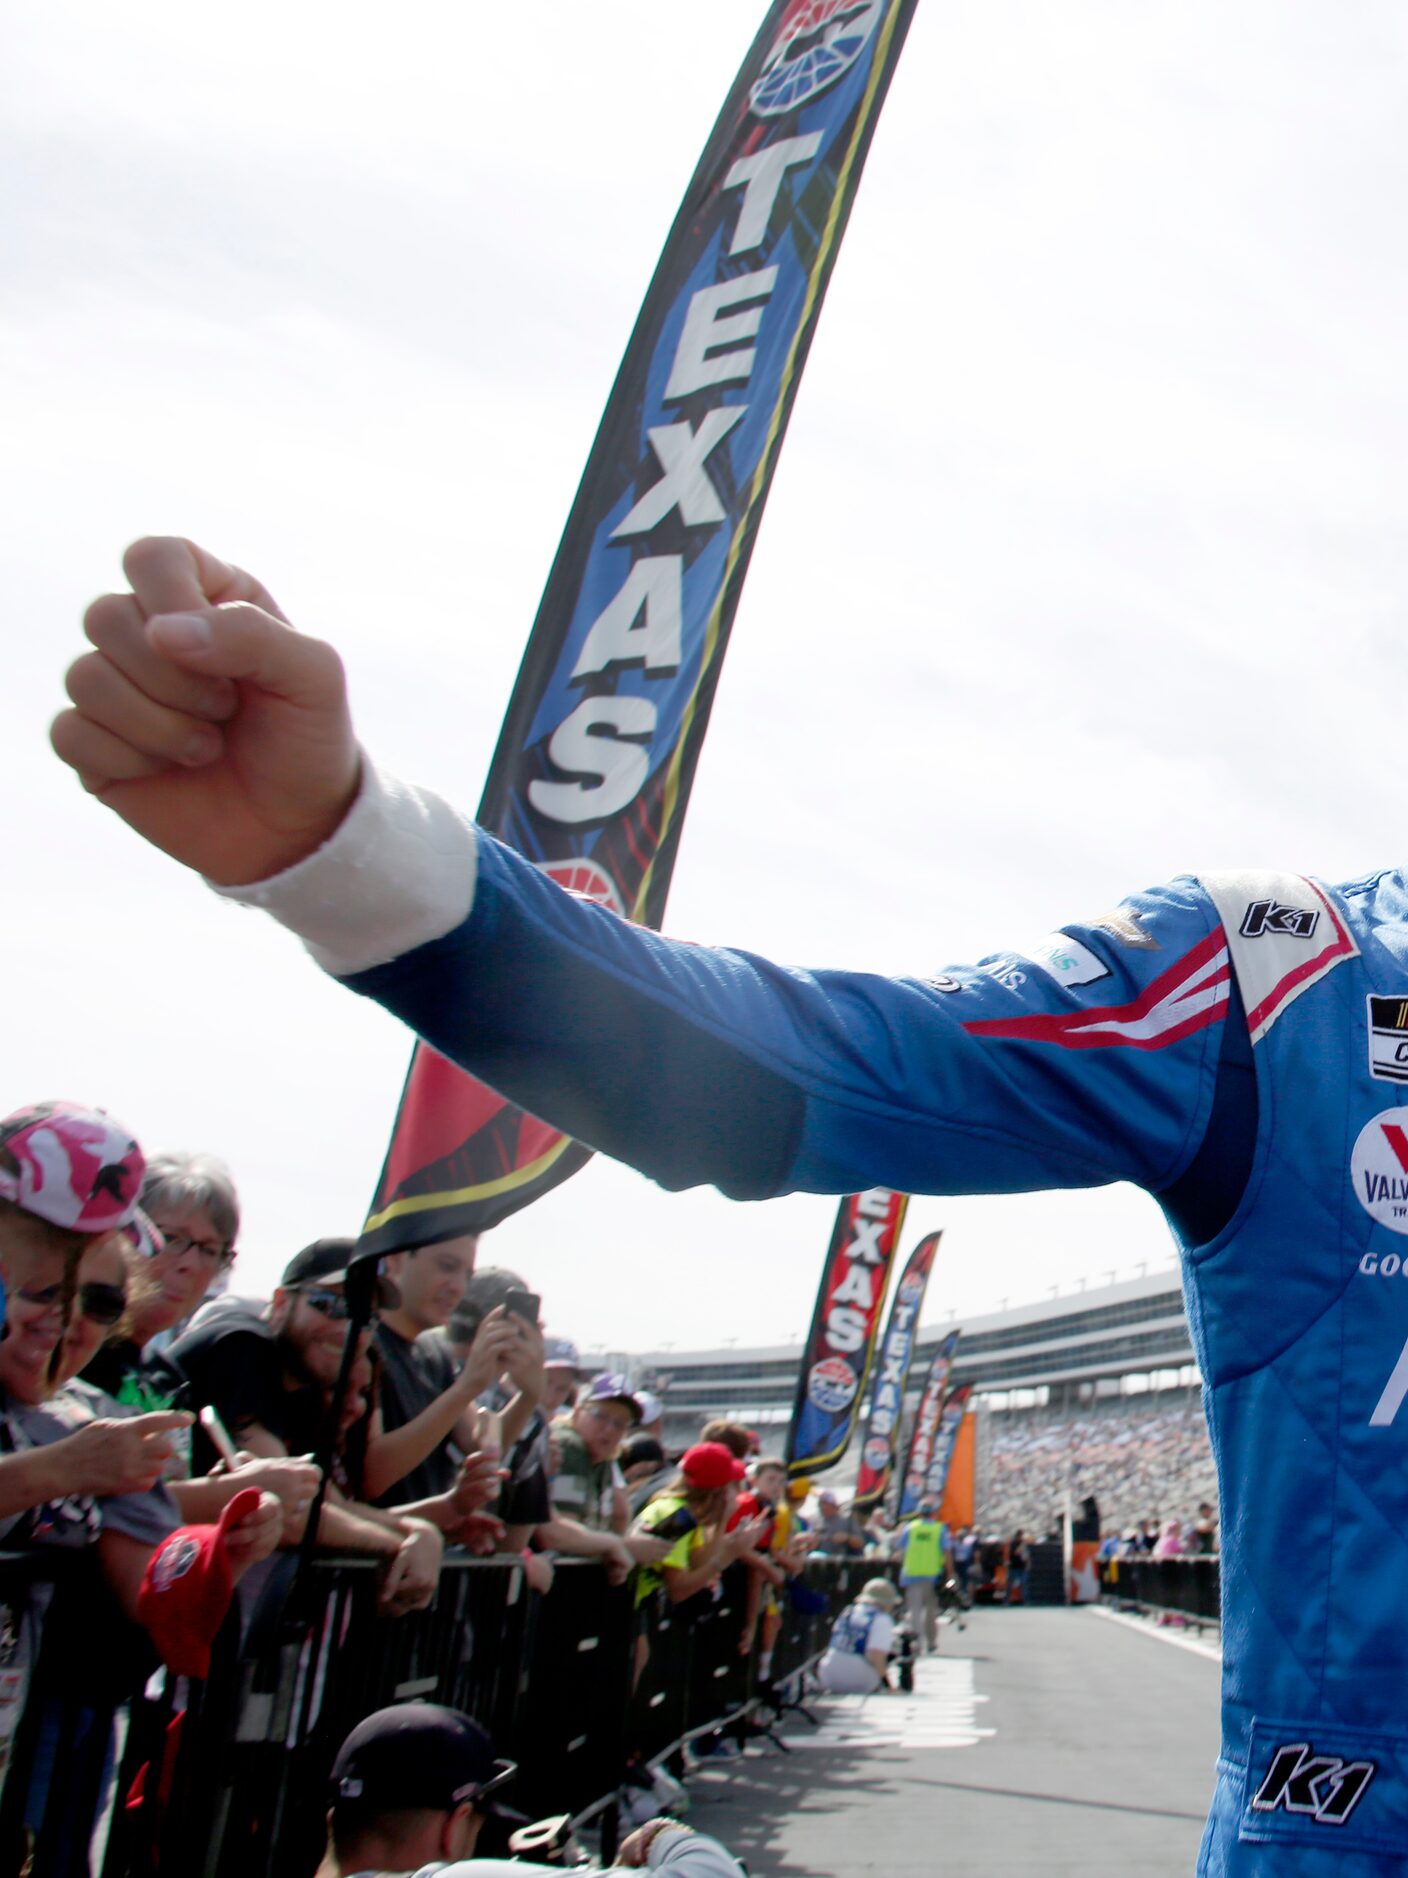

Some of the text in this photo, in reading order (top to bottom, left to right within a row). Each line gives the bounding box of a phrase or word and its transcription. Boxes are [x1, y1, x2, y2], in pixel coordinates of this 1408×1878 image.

[528, 129, 826, 823] TEXAS
[1241, 899, 1320, 938] K1
[825, 1190, 891, 1353] EXAS
[870, 1306, 914, 1435] TEXAS
[1252, 1742, 1374, 1824] K1
